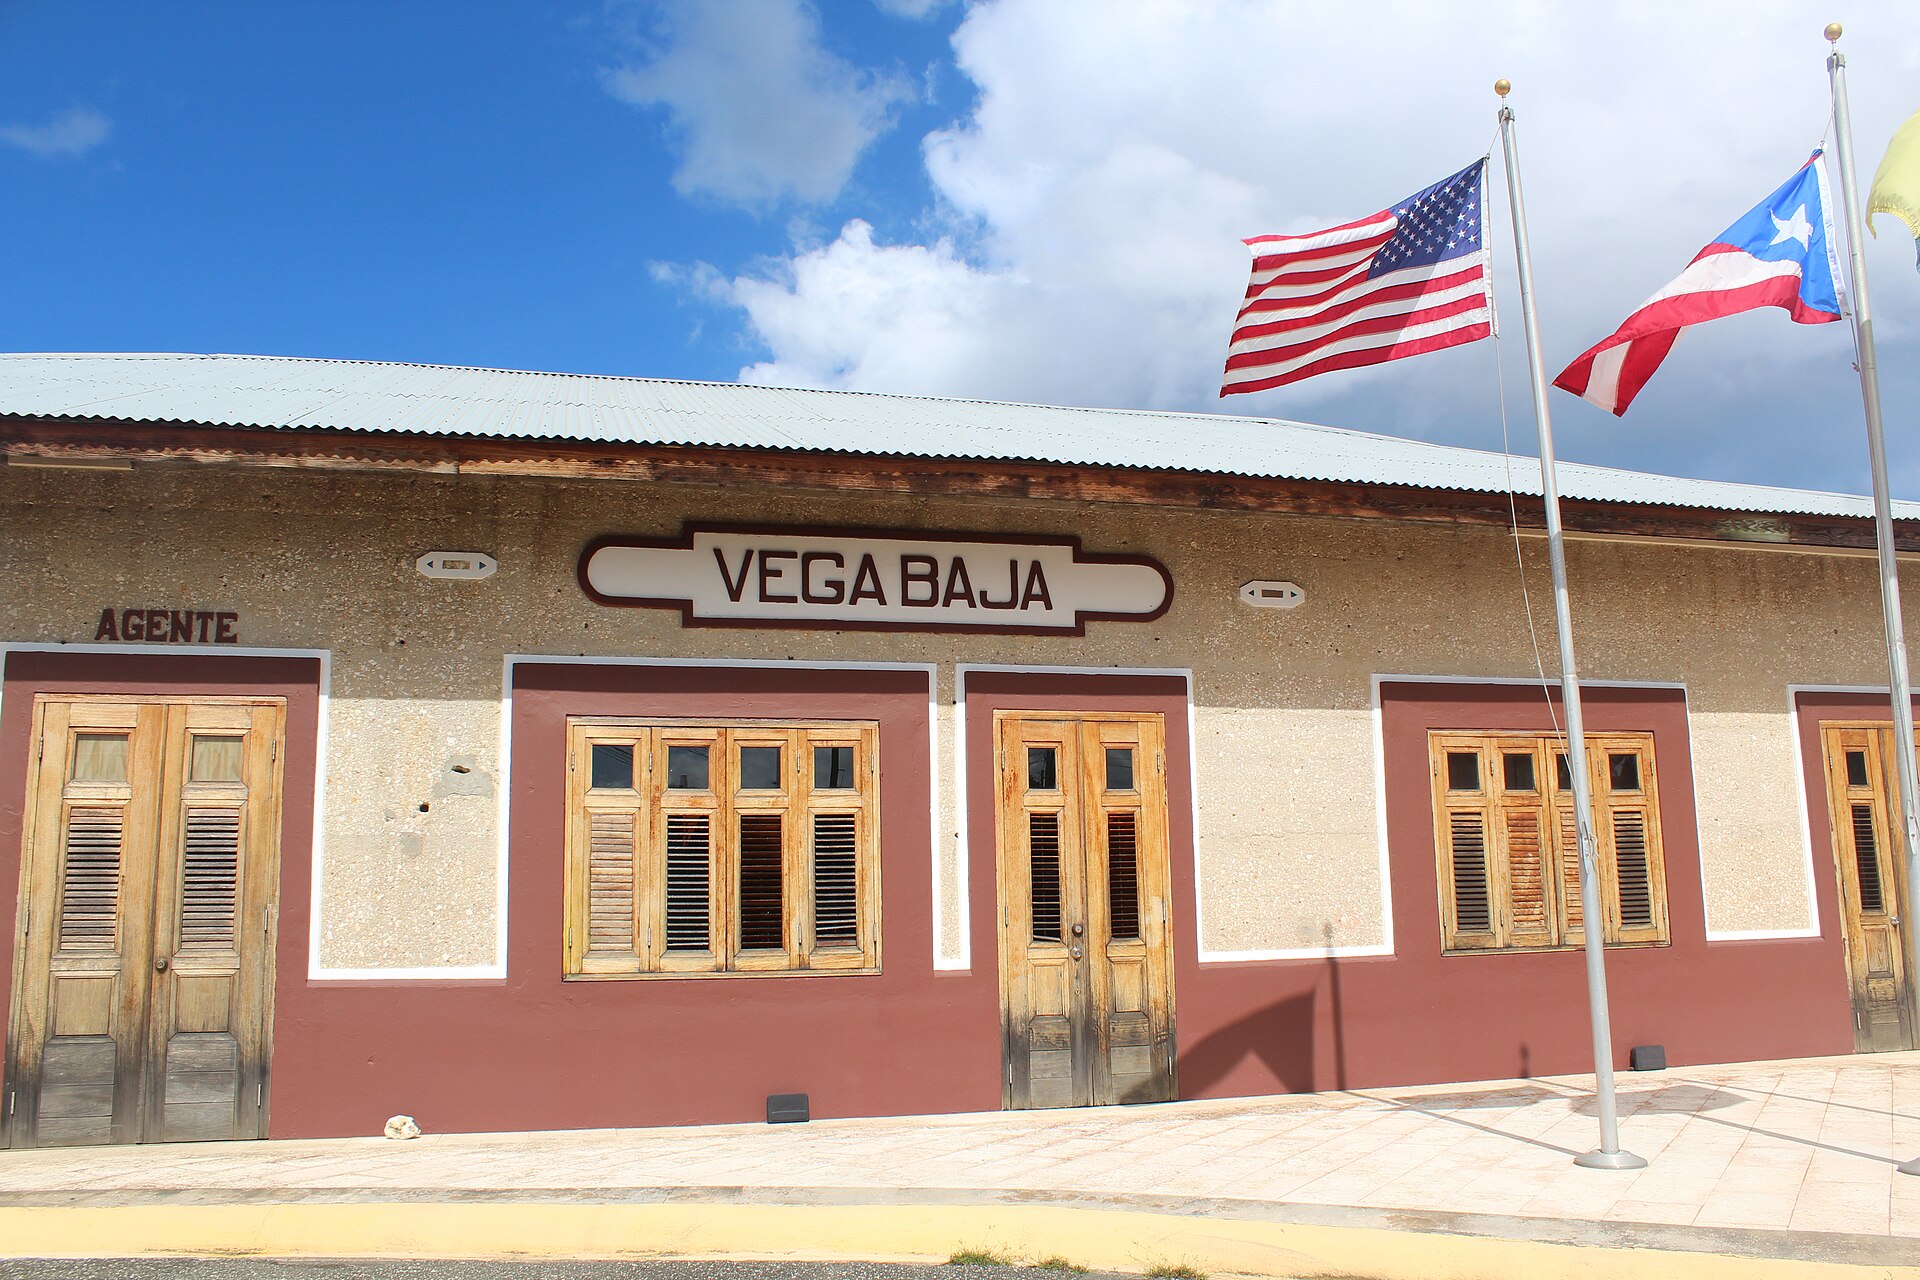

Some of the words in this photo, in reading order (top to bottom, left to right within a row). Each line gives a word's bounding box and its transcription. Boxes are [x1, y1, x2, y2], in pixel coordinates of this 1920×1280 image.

[712, 548, 888, 605] VEGA
[900, 556, 1053, 611] BAJA
[94, 607, 239, 643] AGENTE
